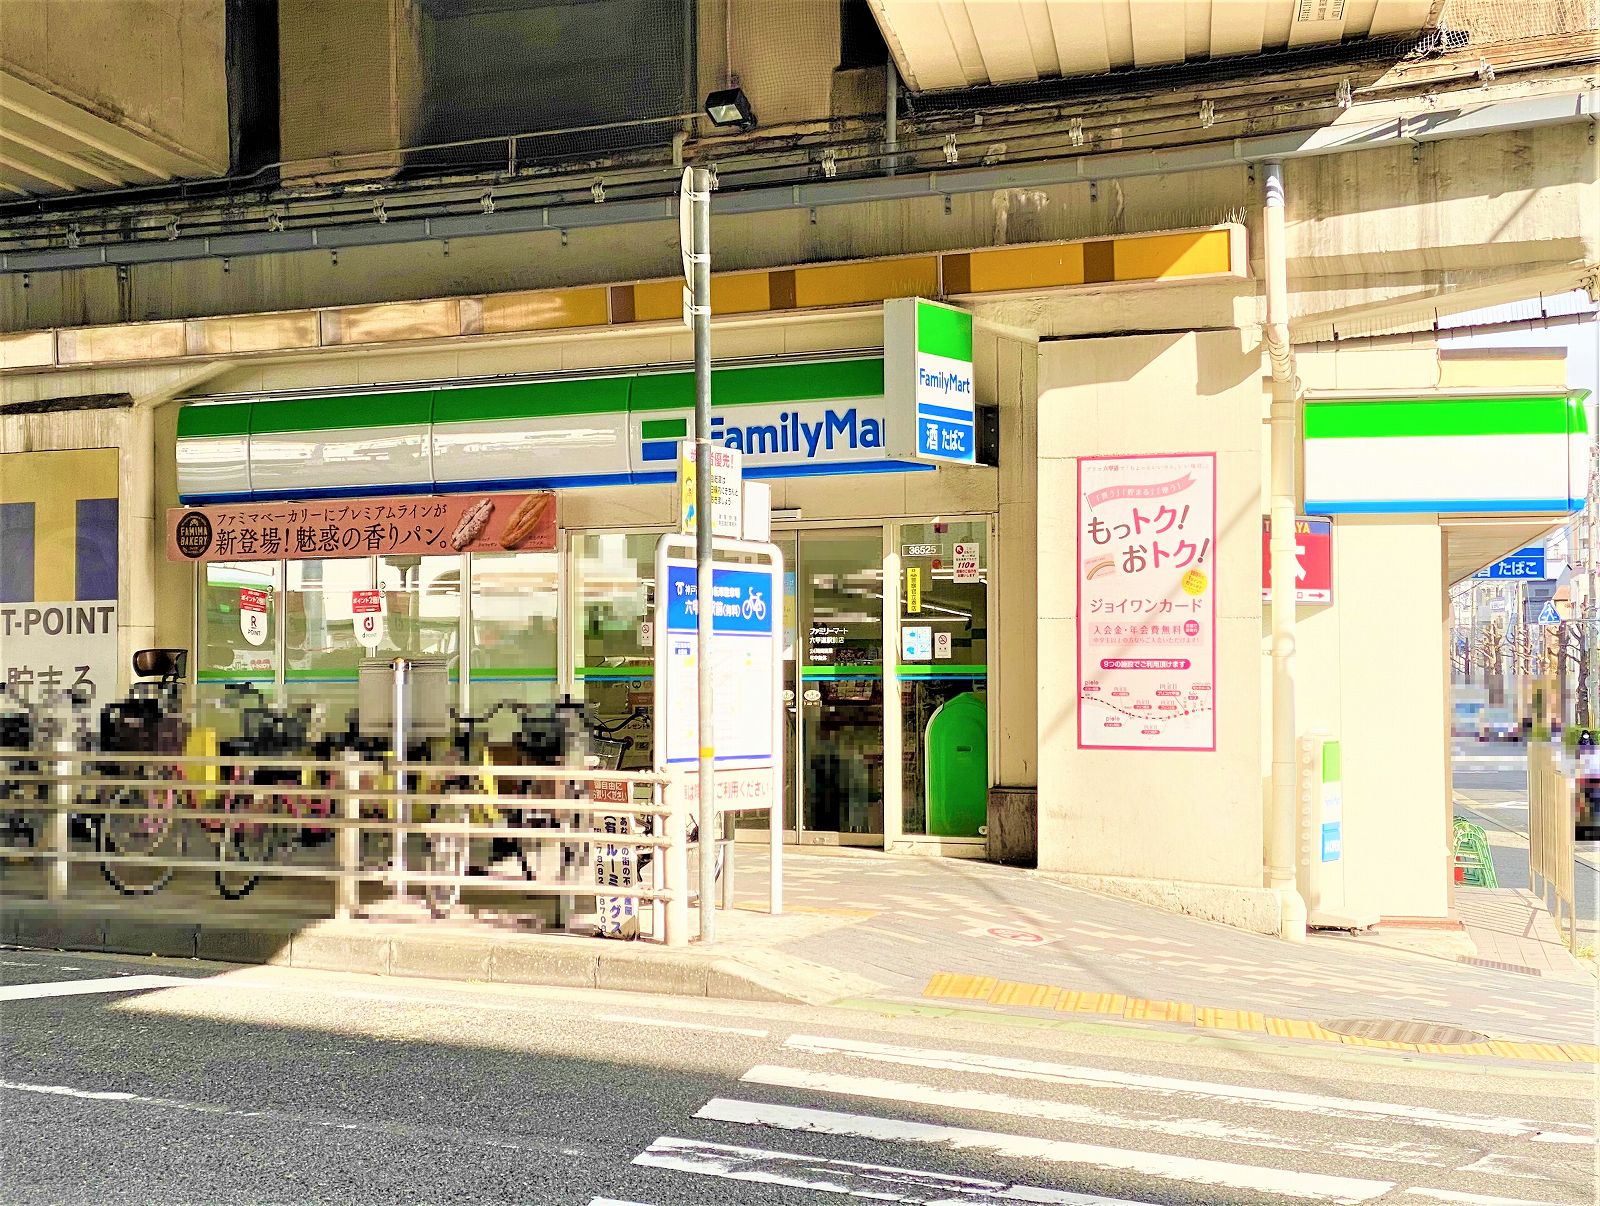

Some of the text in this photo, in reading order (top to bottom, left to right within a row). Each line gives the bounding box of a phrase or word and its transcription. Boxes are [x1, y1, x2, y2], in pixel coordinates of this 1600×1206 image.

[920, 368, 970, 394] FamilyMart
[711, 408, 886, 458] FamilyMa
[926, 423, 965, 451] 酒 たばこ
[217, 503, 447, 527] ファミマベーカリーにプレミアムラインが
[180, 526, 207, 536] FAMIMA
[180, 536, 207, 547] BAKERY
[214, 523, 448, 557] 新登場！魅惑の香りパン。
[909, 545, 937, 555] 36525
[1498, 561, 1537, 576] たばこ
[1090, 598, 1203, 614] ジョイワンカード
[1, 607, 115, 636] T-POINT
[1094, 624, 1182, 635] 入会金・年会費無料
[810, 627, 849, 635] ファミリーマート
